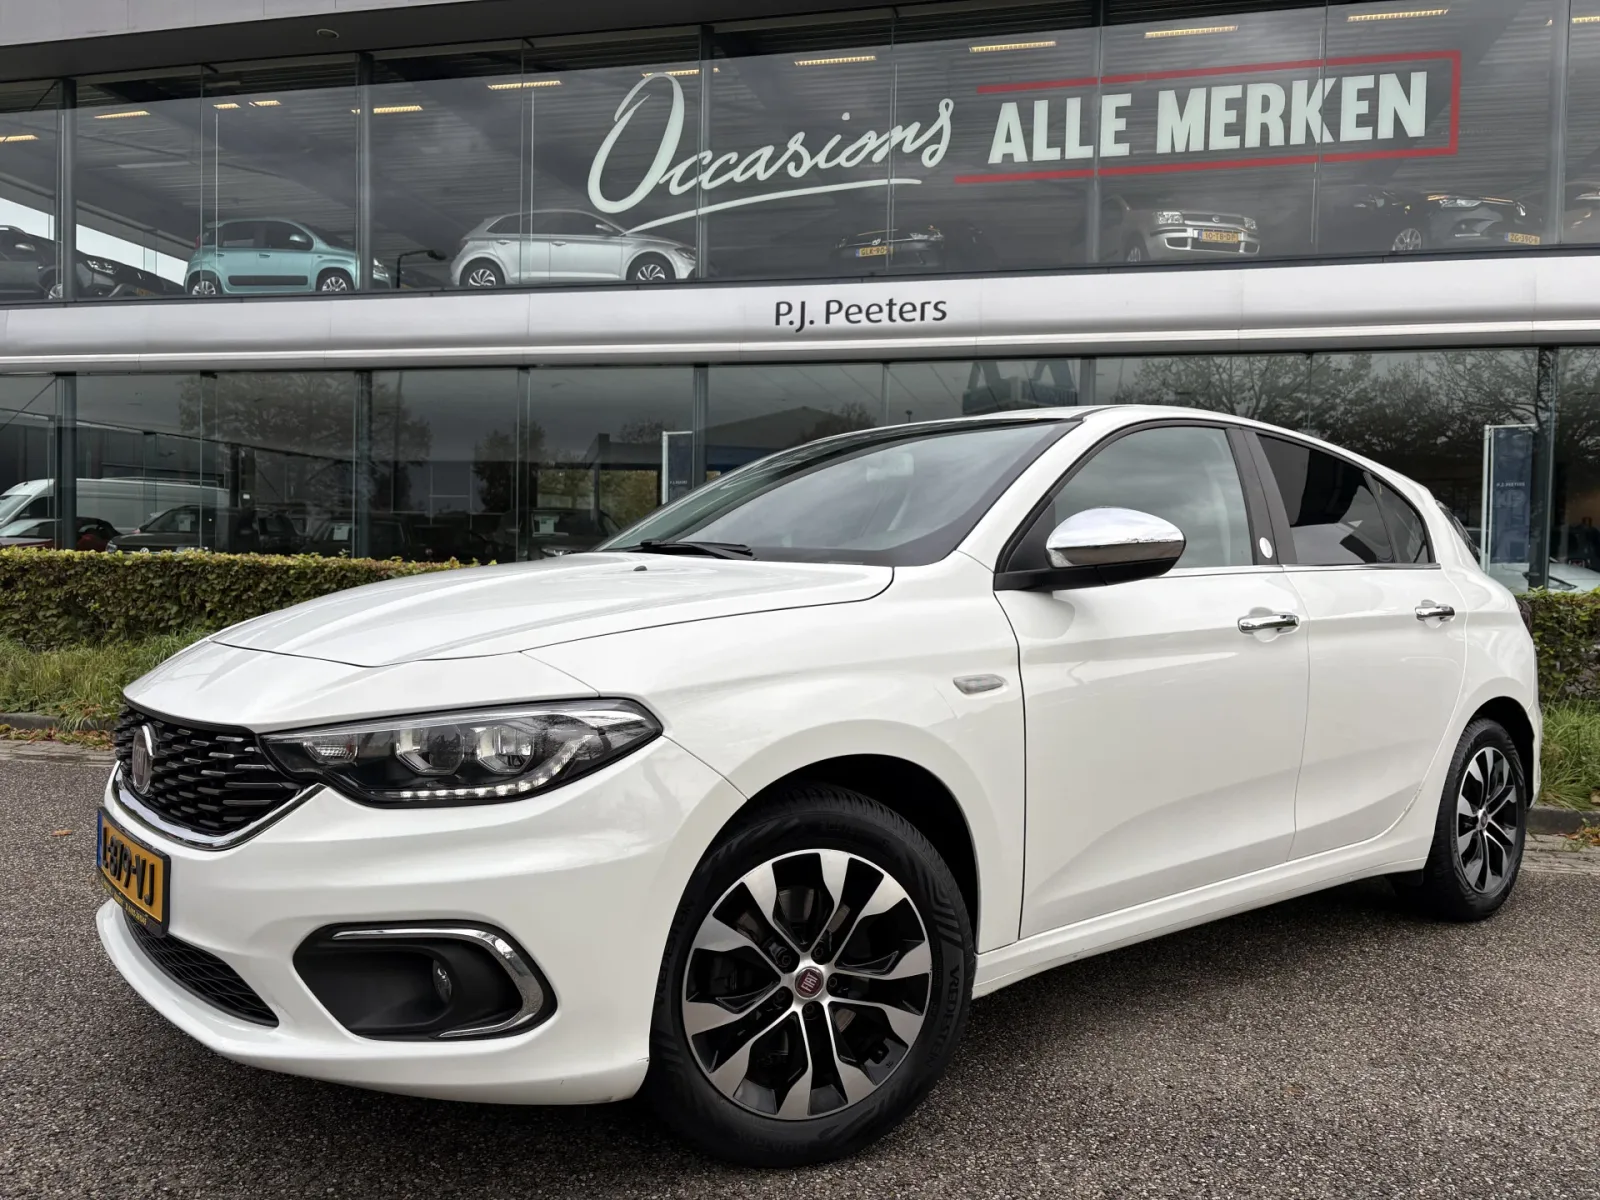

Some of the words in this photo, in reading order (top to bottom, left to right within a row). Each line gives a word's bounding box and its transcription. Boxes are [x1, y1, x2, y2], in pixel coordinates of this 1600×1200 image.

[588, 72, 954, 213] Occasions
[988, 93, 1132, 164] ALLE
[1156, 71, 1428, 154] MERKEN
[775, 300, 815, 333] P.J.
[825, 298, 947, 325] Peeters
[801, 971, 818, 992] FIAT
